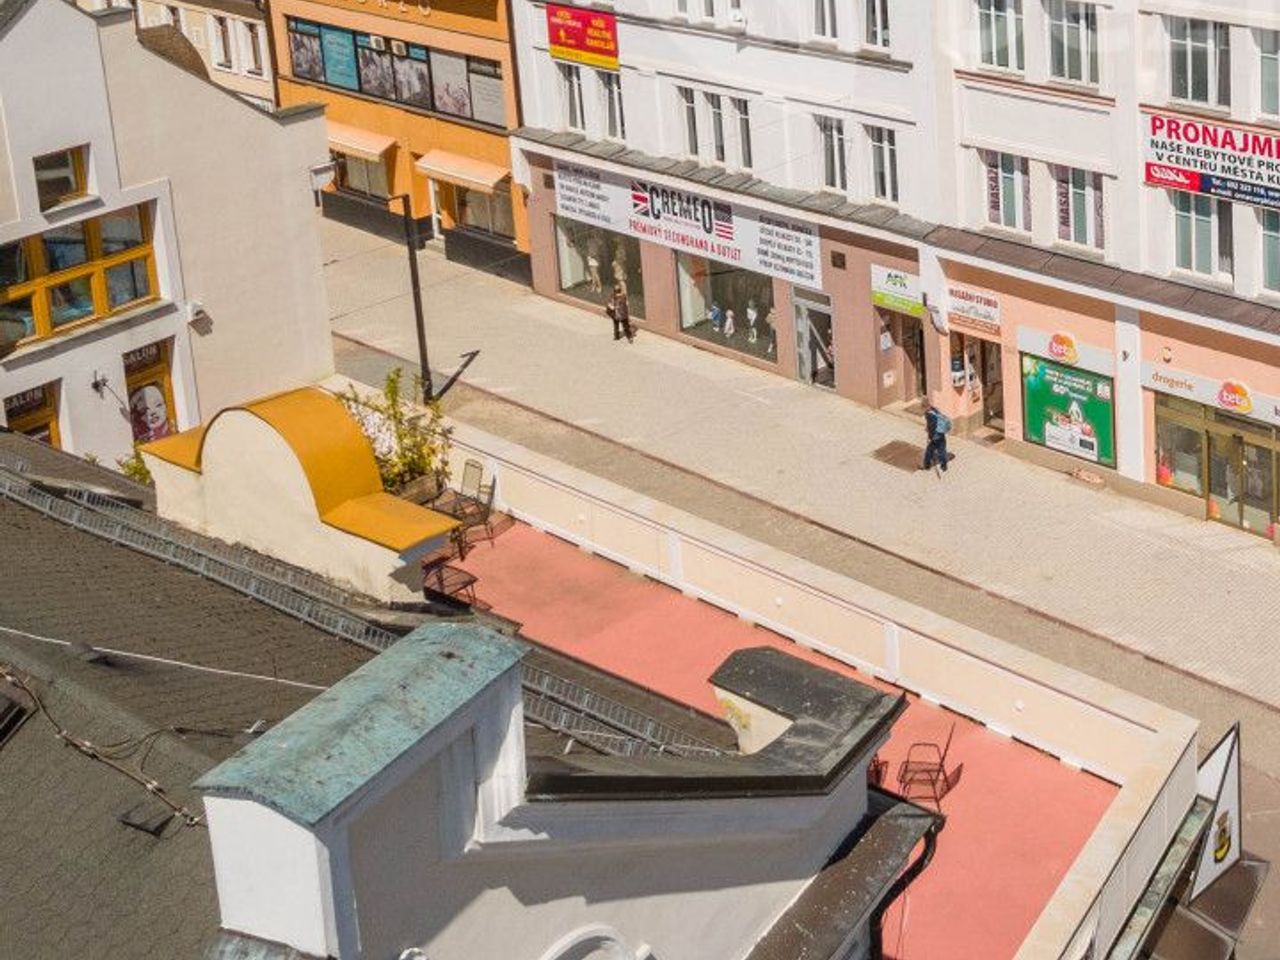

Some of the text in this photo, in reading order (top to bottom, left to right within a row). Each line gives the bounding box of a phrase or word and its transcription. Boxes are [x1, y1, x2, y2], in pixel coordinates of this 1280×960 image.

[1150, 137, 1184, 155] NAŠE
[1186, 147, 1254, 168] NEBYTOVÉ
[1155, 151, 1165, 162] V
[1167, 154, 1217, 172] CENTRU
[1221, 164, 1264, 183] MĚSTA
[649, 185, 713, 234] CREMEO
[1152, 372, 1195, 392] drogerie
